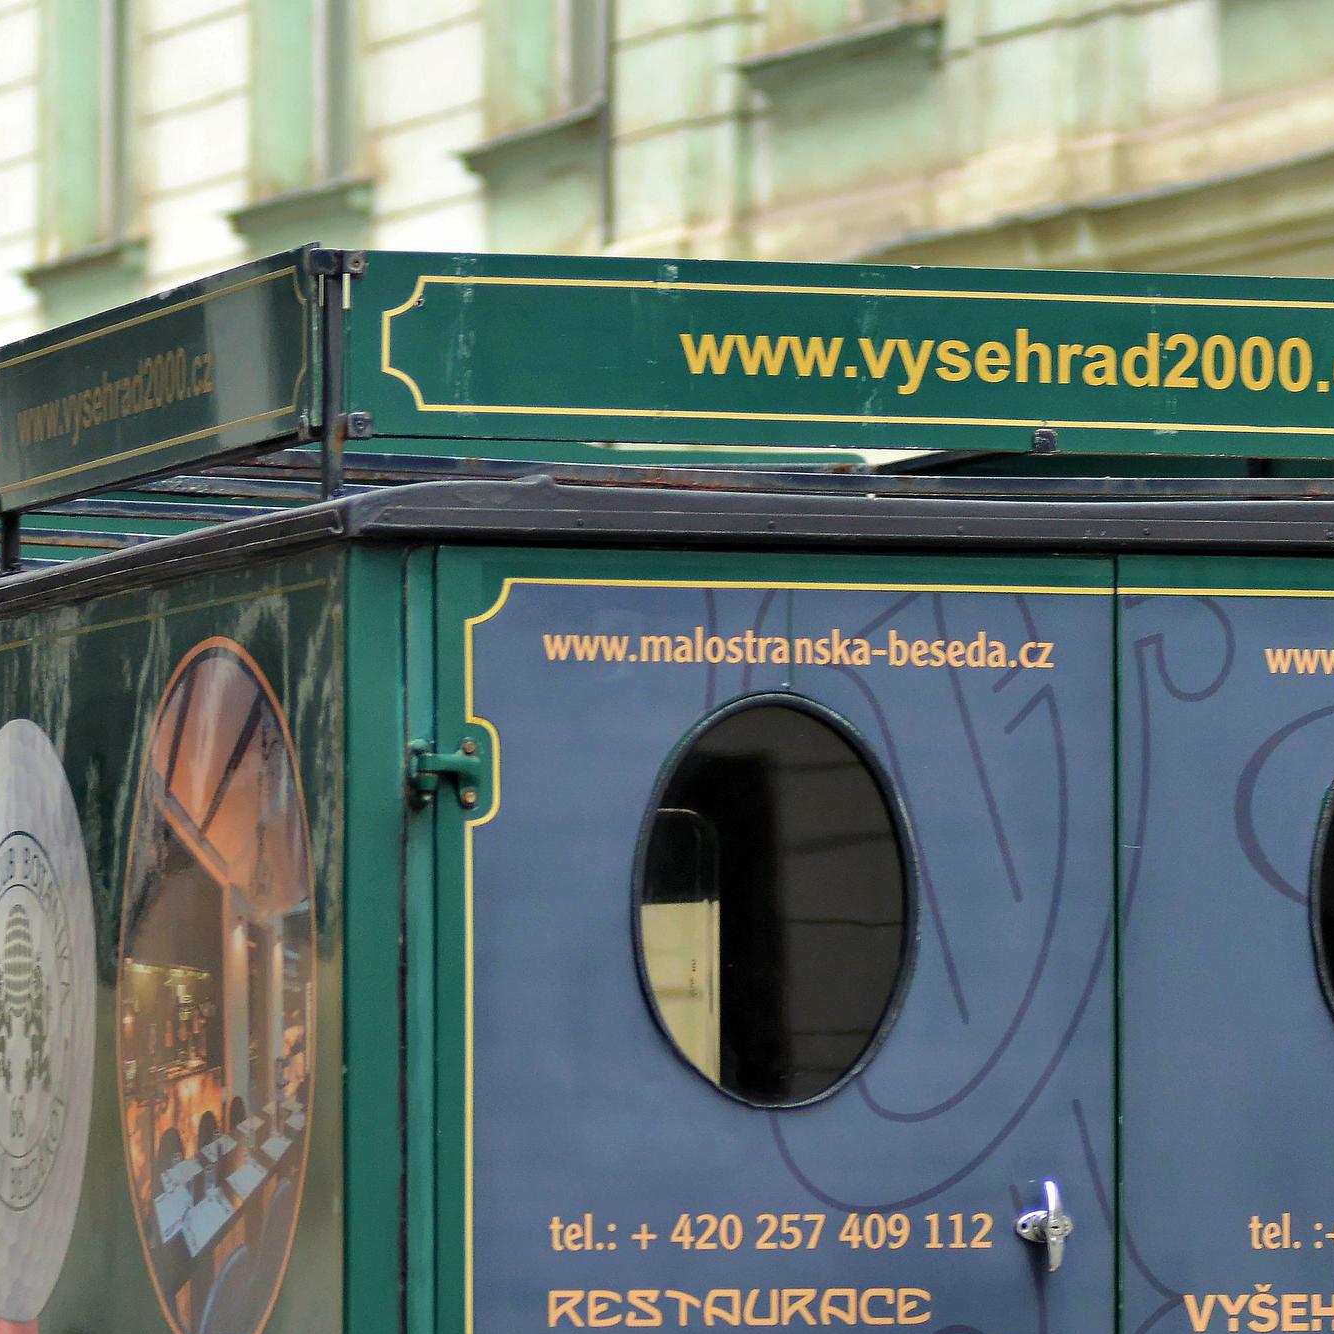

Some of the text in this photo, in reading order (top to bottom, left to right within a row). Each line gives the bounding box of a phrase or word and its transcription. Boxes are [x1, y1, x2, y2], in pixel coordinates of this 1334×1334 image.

[17, 346, 215, 448] www.vysehrad2000.cz
[543, 626, 1054, 668] www.malostranska-beseda.cz
[550, 1212, 993, 1251] tel.: + 420 257 409 112
[1249, 1212, 1302, 1249] tel.
[548, 1287, 931, 1328] RESTAURACE
